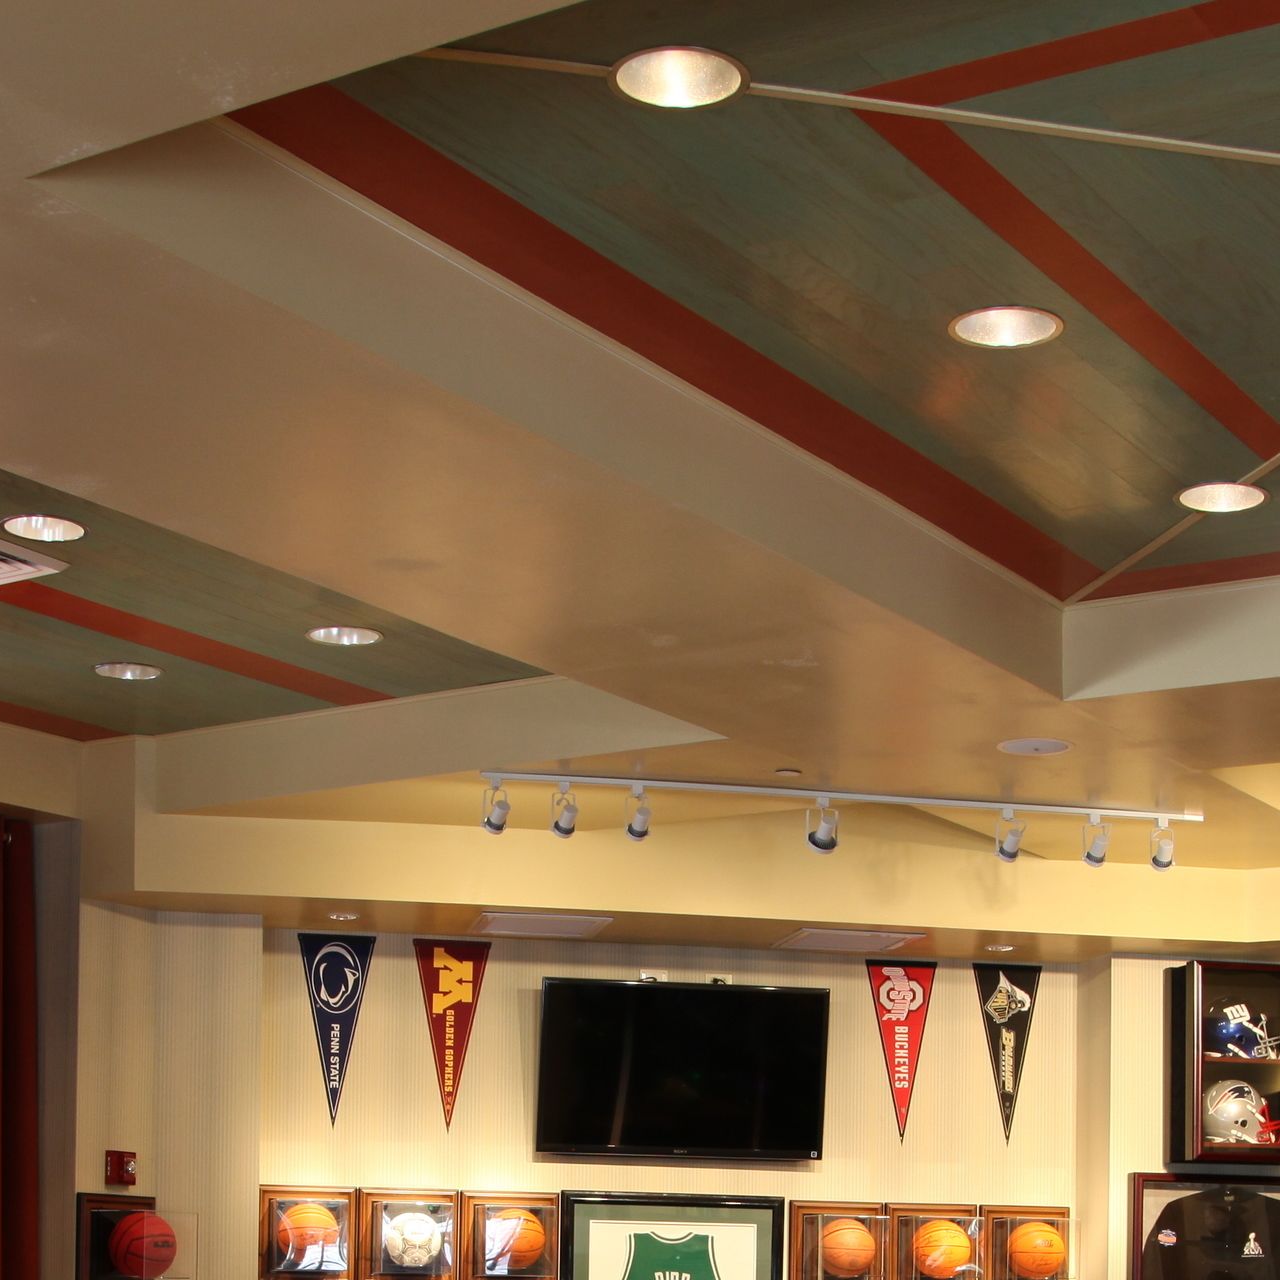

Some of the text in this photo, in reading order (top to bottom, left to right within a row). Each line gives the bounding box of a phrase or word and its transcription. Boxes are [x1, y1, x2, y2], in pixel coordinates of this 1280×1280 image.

[432, 947, 474, 1014] M
[329, 1023, 340, 1089] PENN STATE
[444, 1009, 455, 1093] GOLDEN GOPHERS
[894, 1025, 909, 1089] BUCKEYES
